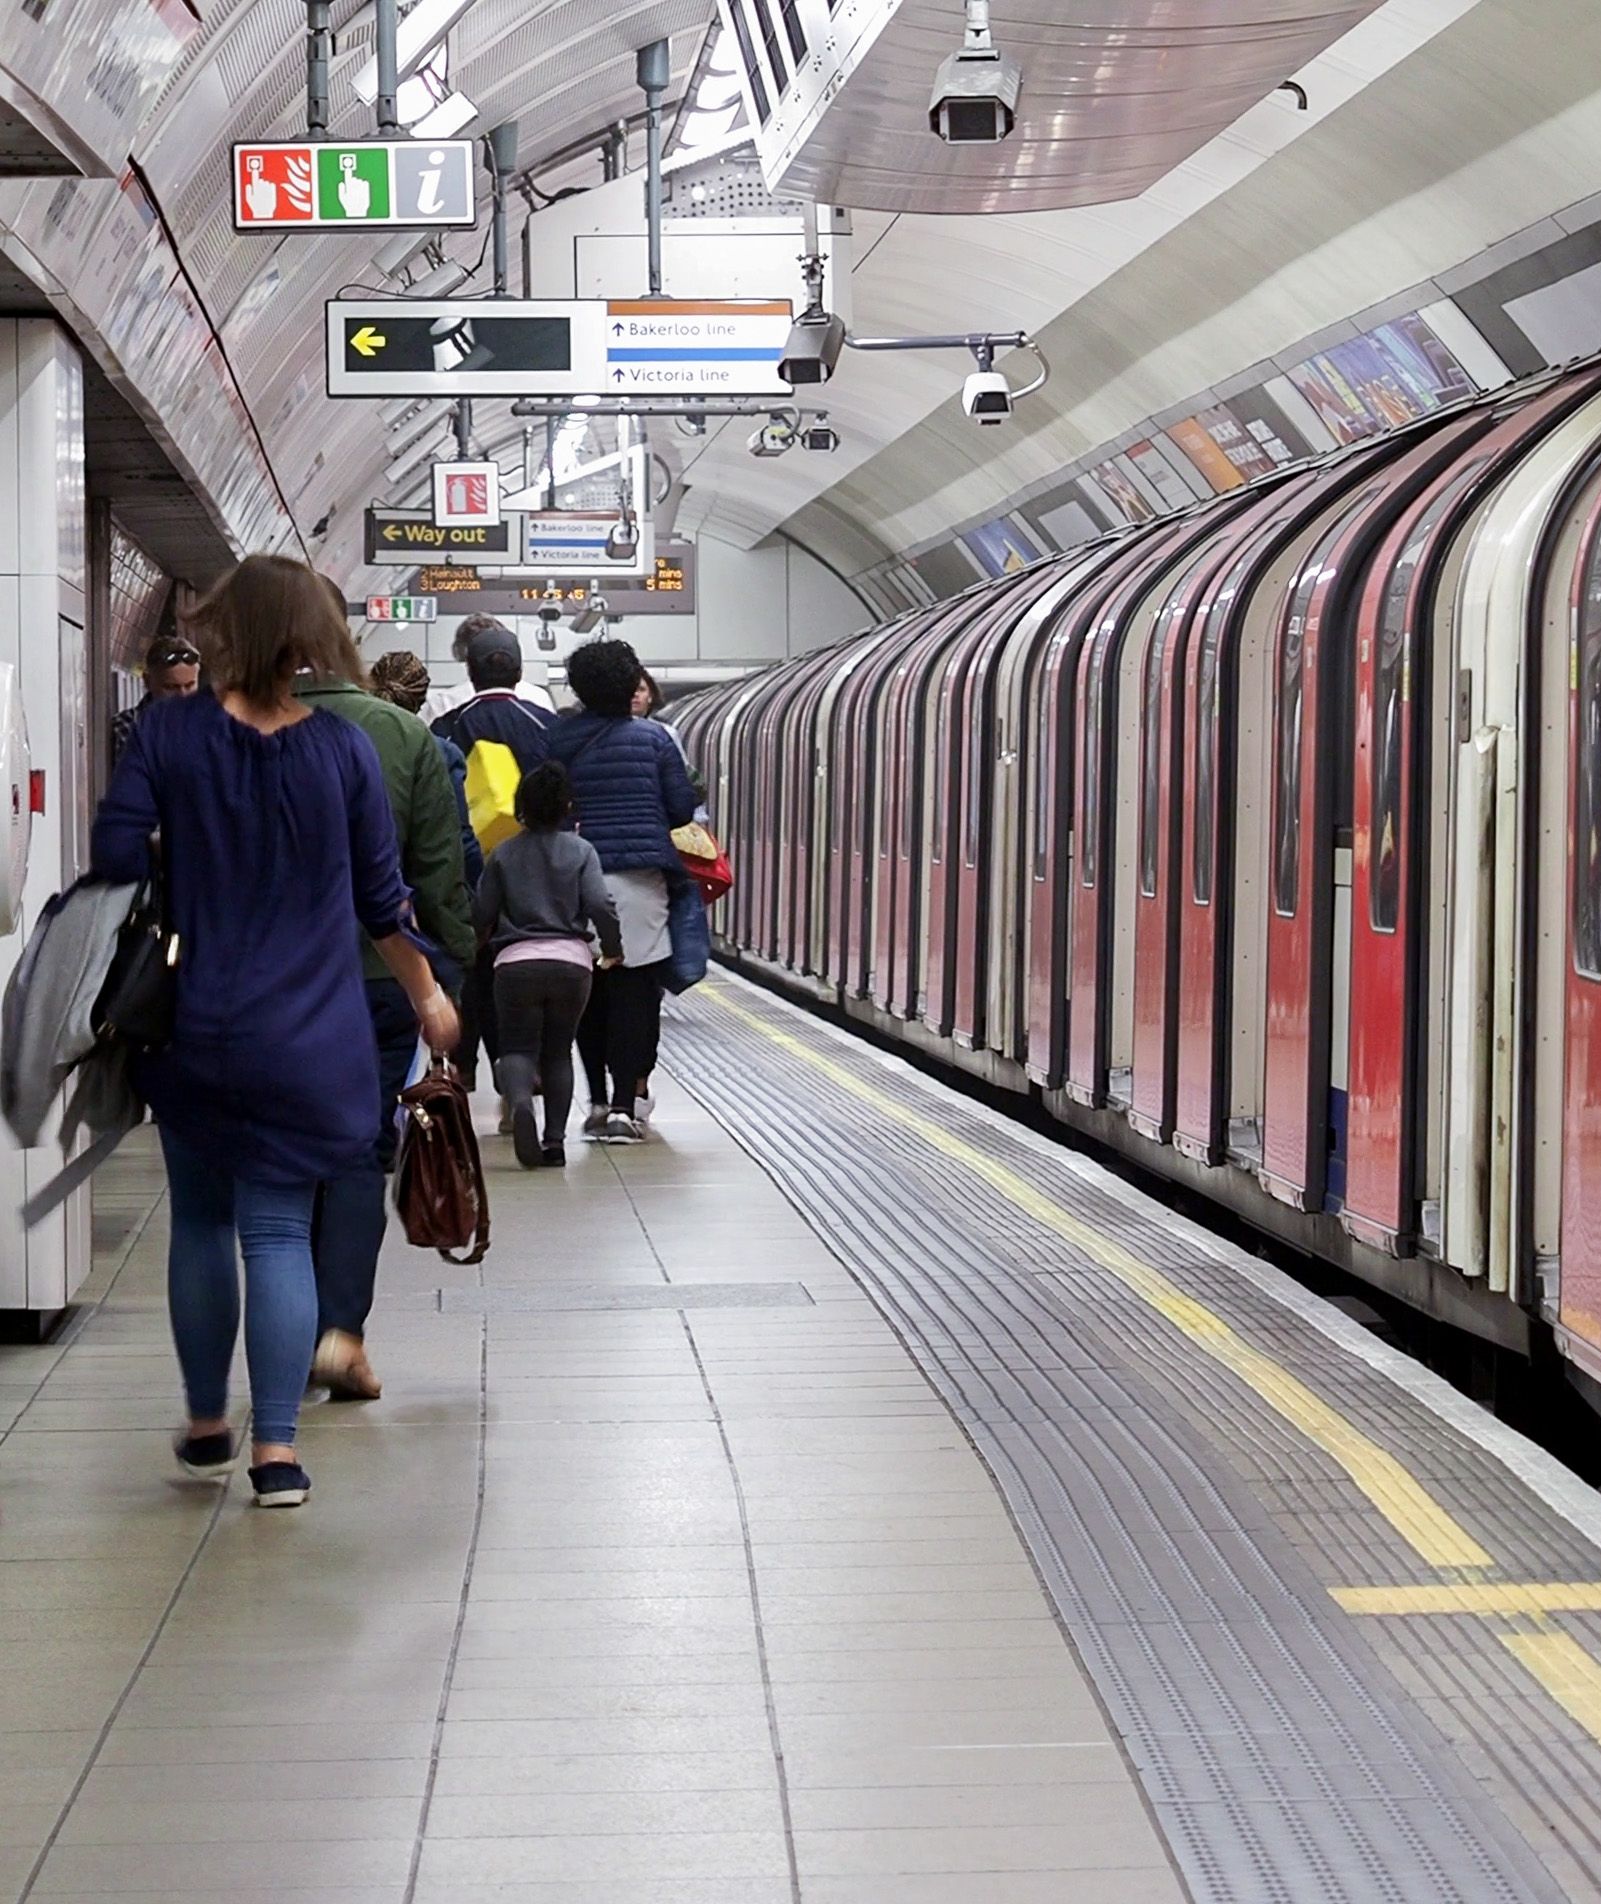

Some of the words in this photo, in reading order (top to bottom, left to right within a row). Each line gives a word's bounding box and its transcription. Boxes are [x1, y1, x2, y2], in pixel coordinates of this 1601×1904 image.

[629, 323, 700, 336] Bakerloo
[707, 323, 736, 336] line
[630, 368, 694, 381] Victoria
[700, 368, 730, 381] line
[541, 523, 583, 532] Bakerloo
[586, 523, 604, 532] line
[404, 525, 446, 546] Way
[450, 527, 486, 543] out
[541, 550, 579, 559] Victoria
[582, 550, 600, 559] line
[658, 568, 683, 578] mins
[430, 580, 481, 592] Loughton
[646, 578, 655, 591] 5
[658, 579, 683, 590] mins
